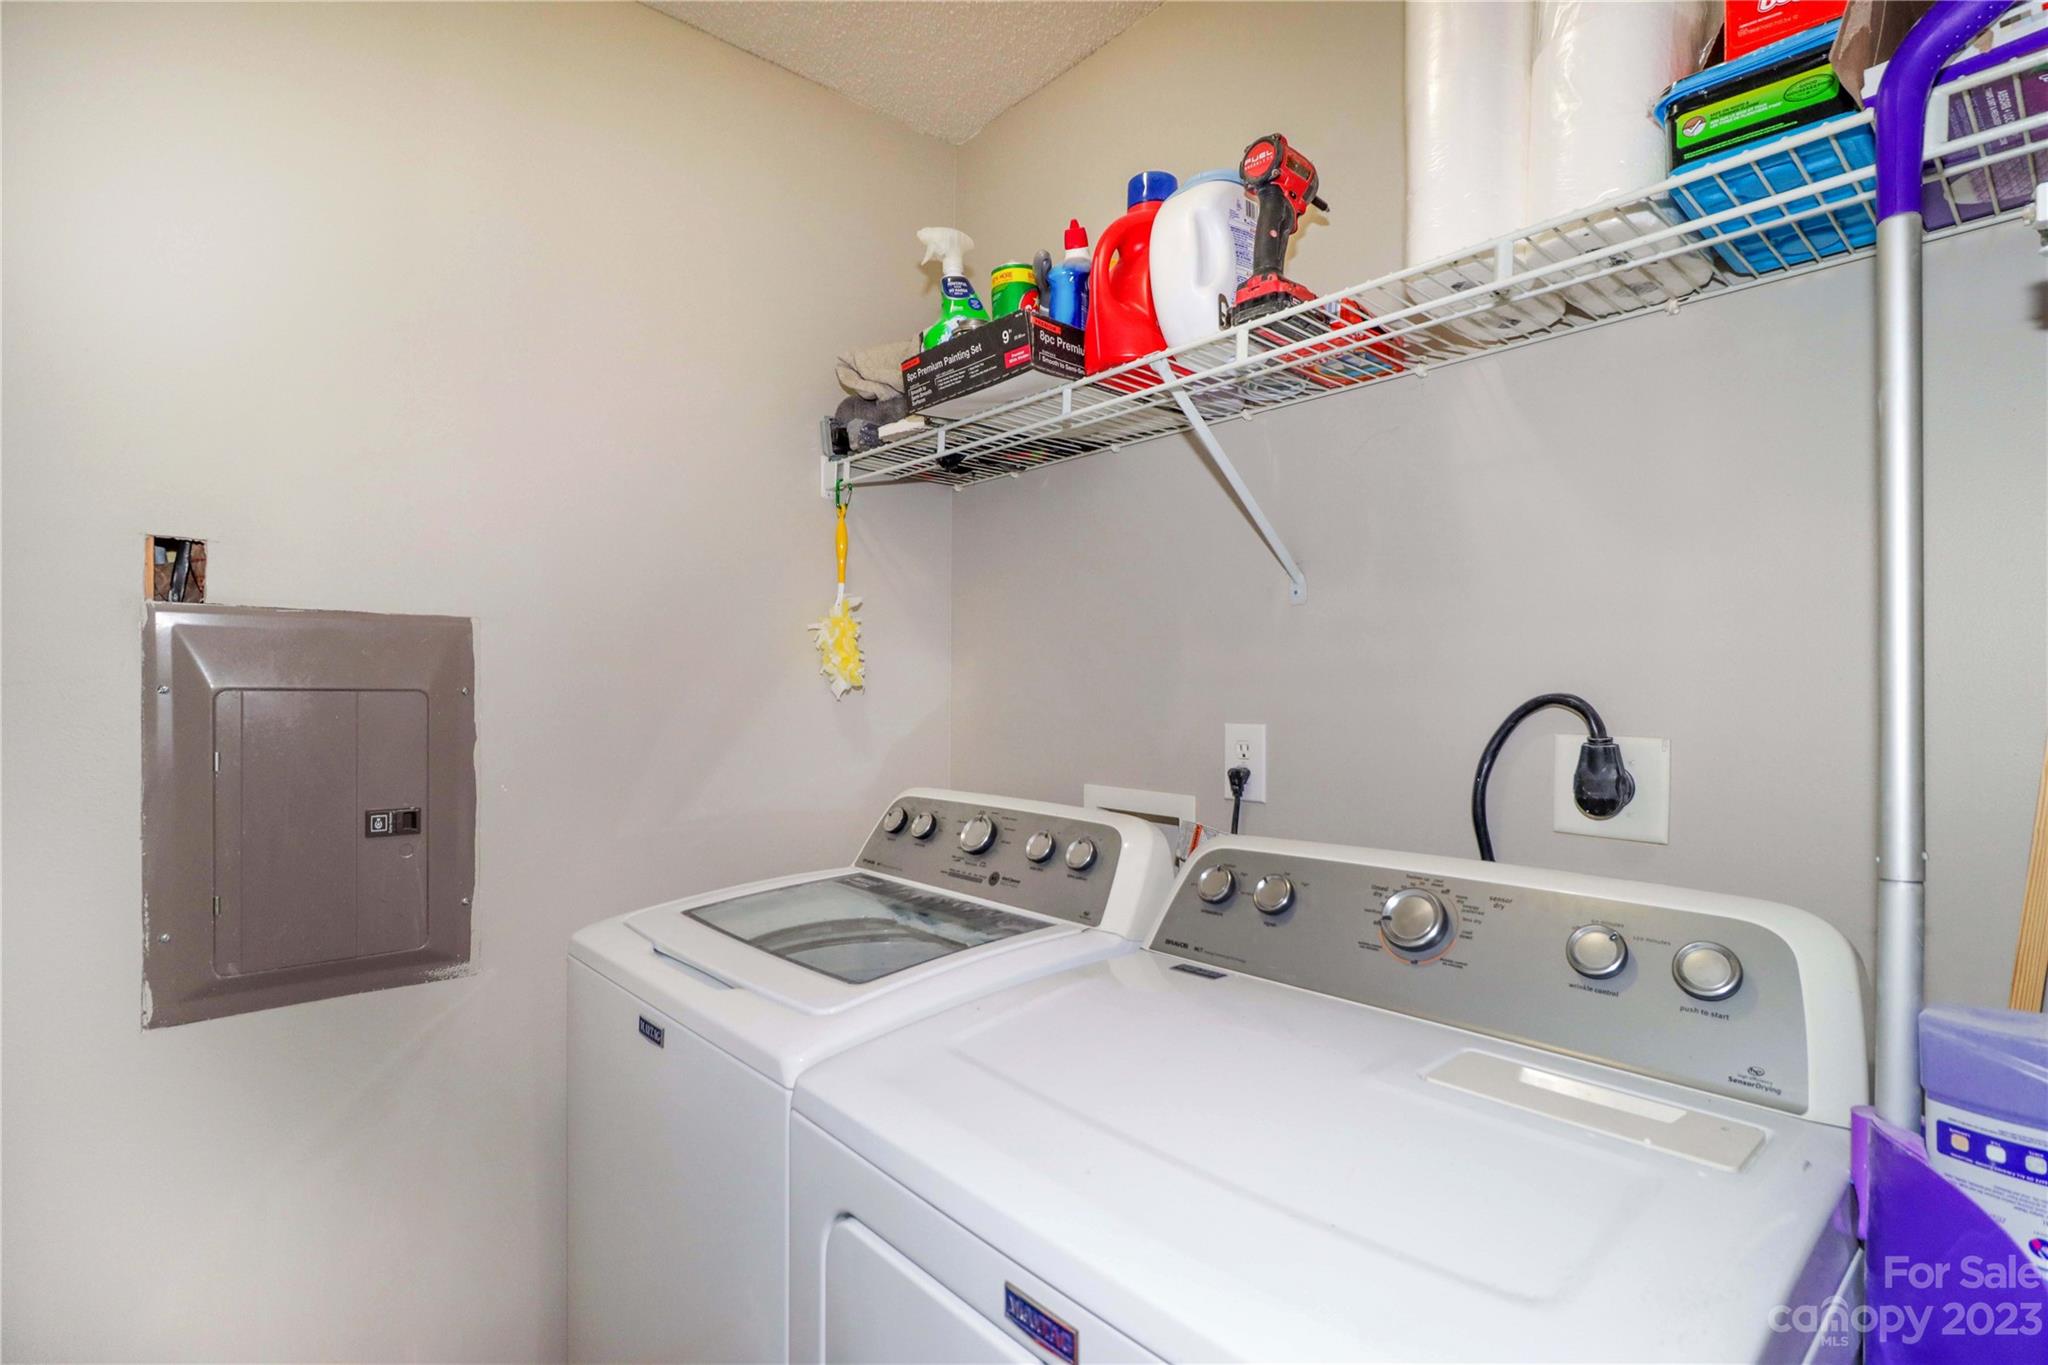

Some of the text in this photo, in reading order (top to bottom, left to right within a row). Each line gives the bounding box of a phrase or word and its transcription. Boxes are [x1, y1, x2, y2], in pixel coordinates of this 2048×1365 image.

[1244, 150, 1273, 166] FUEL
[1039, 330, 1055, 345] 8pc
[1056, 336, 1085, 356] Premiu
[907, 372, 918, 382] 8pc
[917, 360, 943, 376] Premium
[943, 349, 970, 366] Painting
[970, 343, 983, 355] Set
[1568, 982, 1619, 997] wrinkle control
[1680, 1005, 1730, 1021] push to start
[1727, 1075, 1782, 1096] SensorDrying
